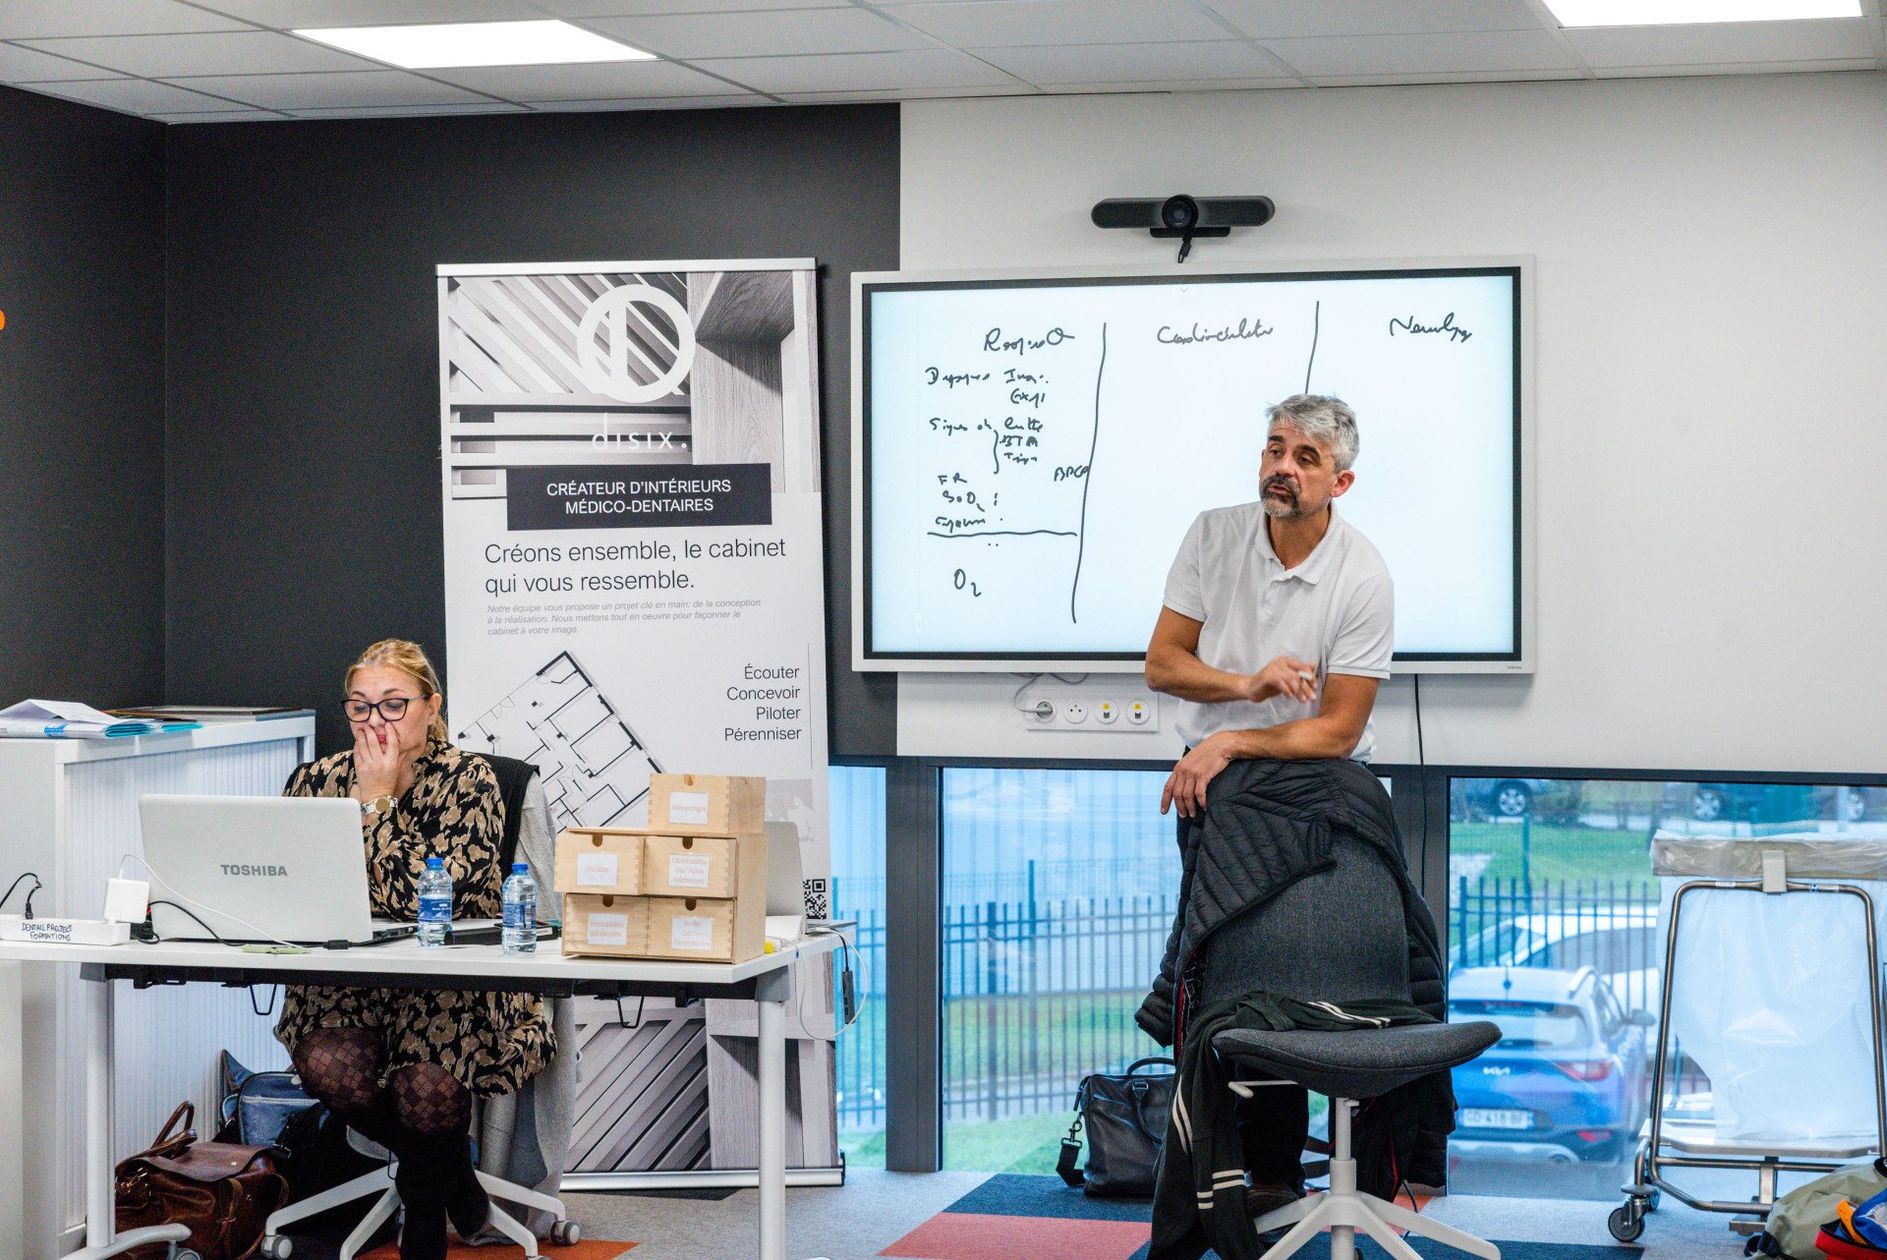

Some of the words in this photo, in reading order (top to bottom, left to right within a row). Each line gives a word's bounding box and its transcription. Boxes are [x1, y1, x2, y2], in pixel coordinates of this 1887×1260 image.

[547, 480, 626, 496] CRÉATEUR
[630, 478, 732, 494] D'INTÉRIEURS
[565, 498, 714, 514] MÉDICO-DENTAIRES
[484, 543, 562, 564] Créons
[568, 540, 677, 562] ensemble,
[684, 540, 703, 559] le
[708, 538, 787, 558] cabinet
[485, 574, 518, 598] qui
[523, 575, 574, 592] vous
[580, 570, 696, 591] ressemble.
[487, 604, 511, 614] Notre
[512, 603, 541, 615] équipe
[544, 604, 563, 612] vous
[564, 602, 600, 613] propose
[602, 602, 613, 611] un
[614, 600, 639, 612] projet
[655, 601, 666, 609] en
[692, 599, 704, 608] de
[705, 599, 714, 608] la
[715, 598, 762, 610] conception
[494, 615, 503, 624] la
[550, 613, 574, 623] Nous
[575, 612, 610, 623] mettons
[611, 611, 628, 621] tout
[629, 612, 640, 621] en
[672, 611, 692, 622] pour
[694, 609, 732, 622] façonner
[733, 609, 741, 618] le
[487, 625, 519, 636] cabinet
[528, 626, 551, 635] votre
[744, 663, 800, 680] Écouter
[726, 685, 801, 701] Concevoir
[755, 706, 802, 720] Piloter
[724, 726, 802, 742] Pérenniser
[220, 864, 289, 877] TOSHIBA
